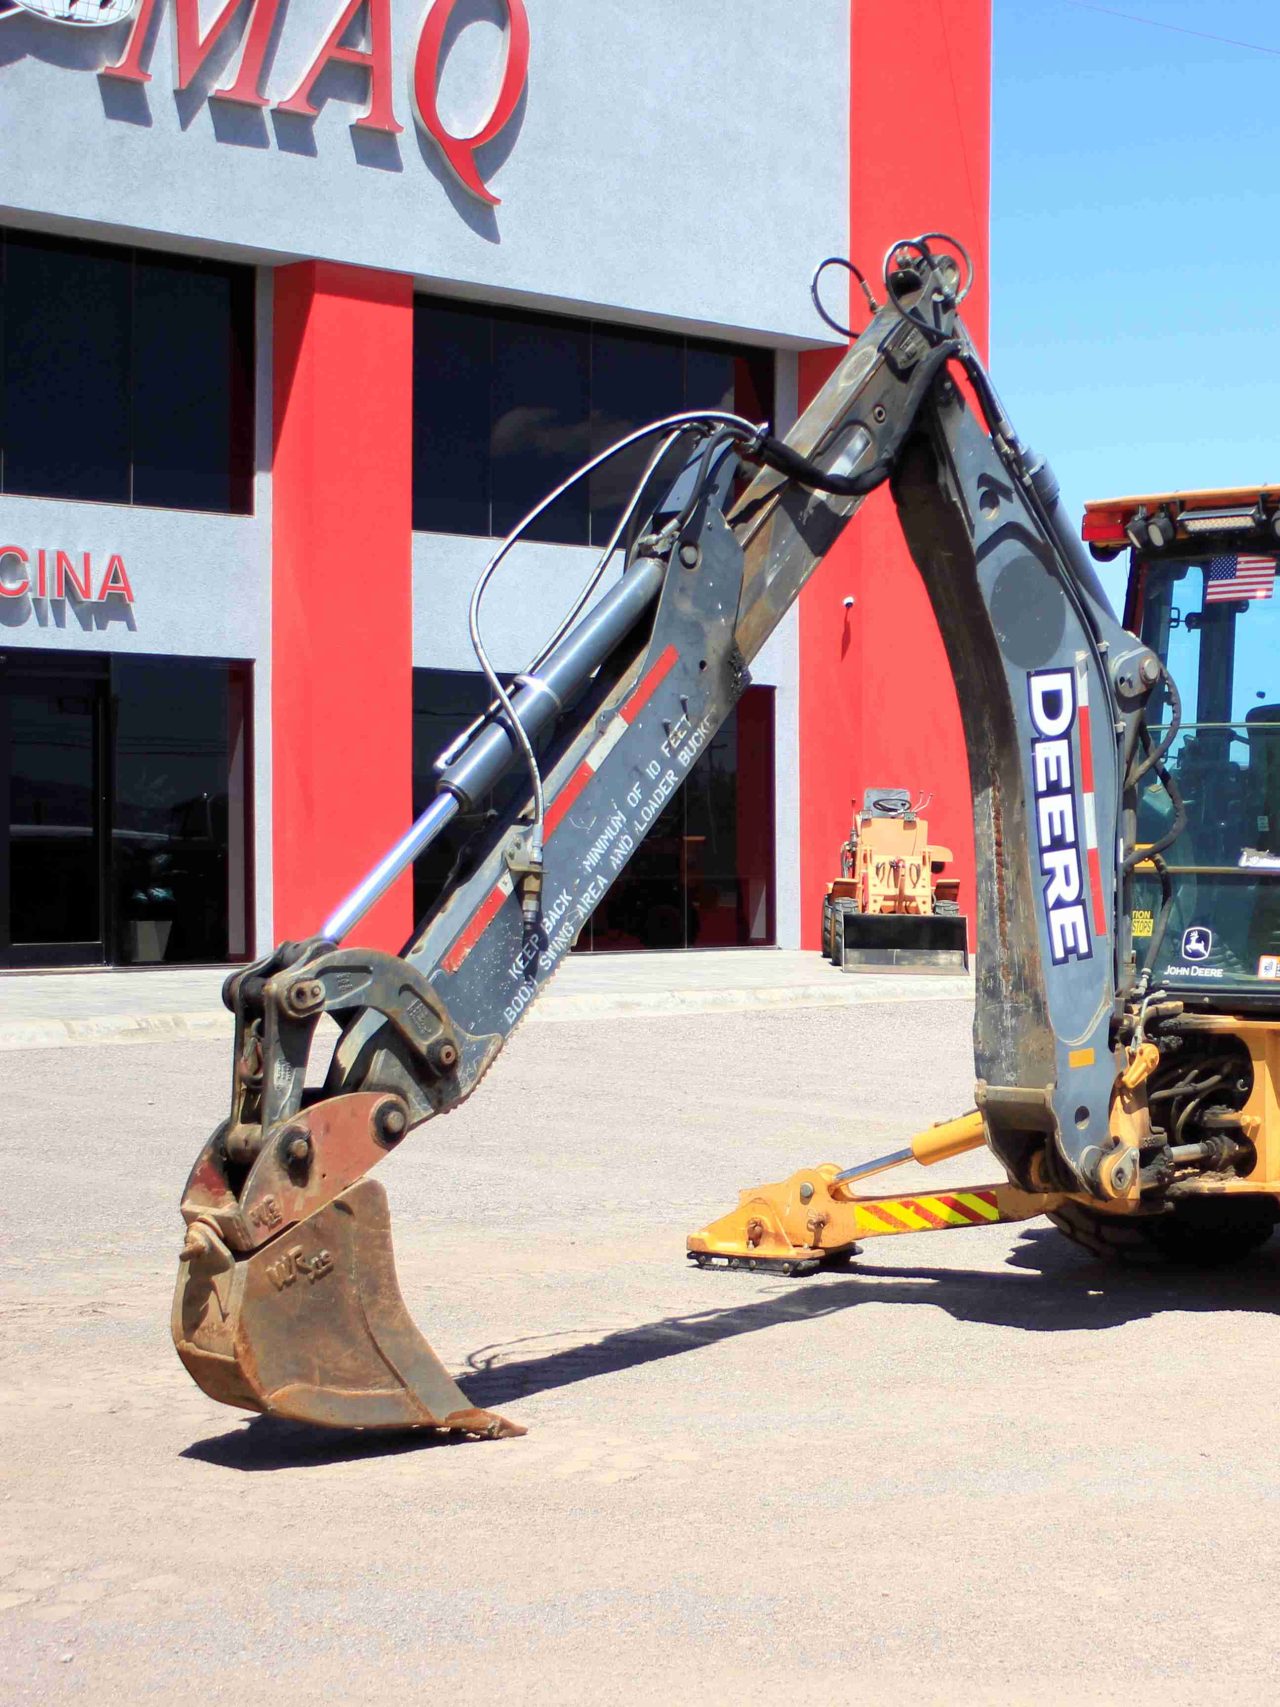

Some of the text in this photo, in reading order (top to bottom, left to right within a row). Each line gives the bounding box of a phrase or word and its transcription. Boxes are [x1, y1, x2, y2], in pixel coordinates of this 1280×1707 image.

[0, 545, 135, 603] CINA
[503, 975, 538, 1025] BOOM
[539, 921, 575, 971] SWING
[576, 875, 609, 920] AREA
[610, 834, 634, 870] AND
[634, 769, 679, 832] LOADER
[508, 933, 540, 980] KEEP
[541, 888, 572, 935] BACK
[583, 809, 627, 873] MINIMUM
[626, 781, 642, 808] OF
[645, 760, 661, 780] 10
[661, 713, 692, 758] FEET
[1029, 670, 1091, 961] DEERE
[1164, 964, 1224, 977] JOHN DEERE
